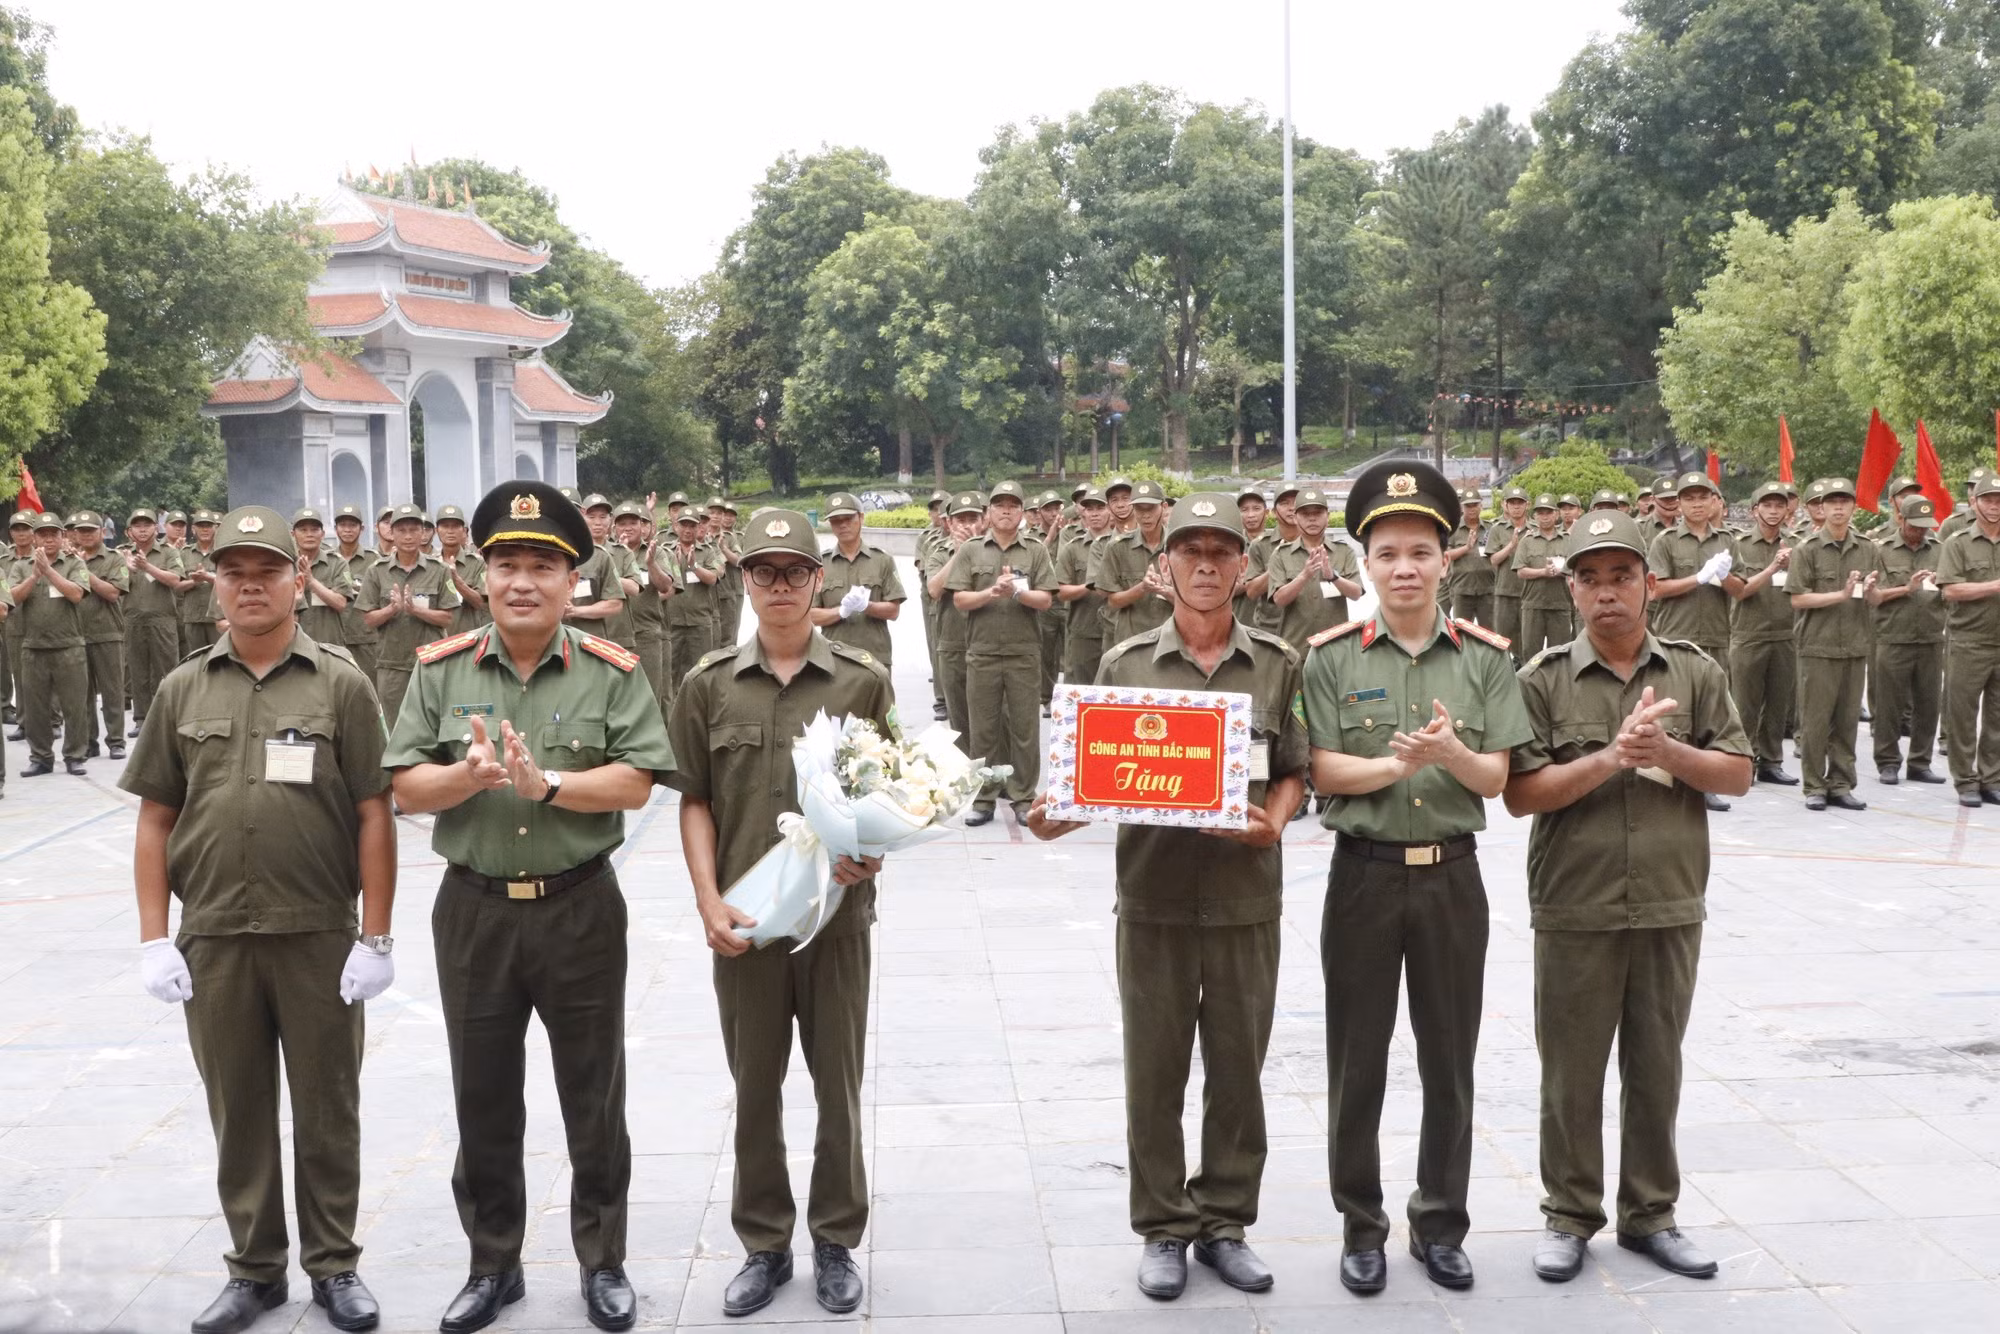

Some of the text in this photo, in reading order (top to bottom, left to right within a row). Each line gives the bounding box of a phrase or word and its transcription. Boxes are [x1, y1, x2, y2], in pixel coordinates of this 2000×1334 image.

[1089, 740, 1211, 759] CÔNG AN TỈNH BẮC NINH
[1114, 762, 1183, 798] Tặng
